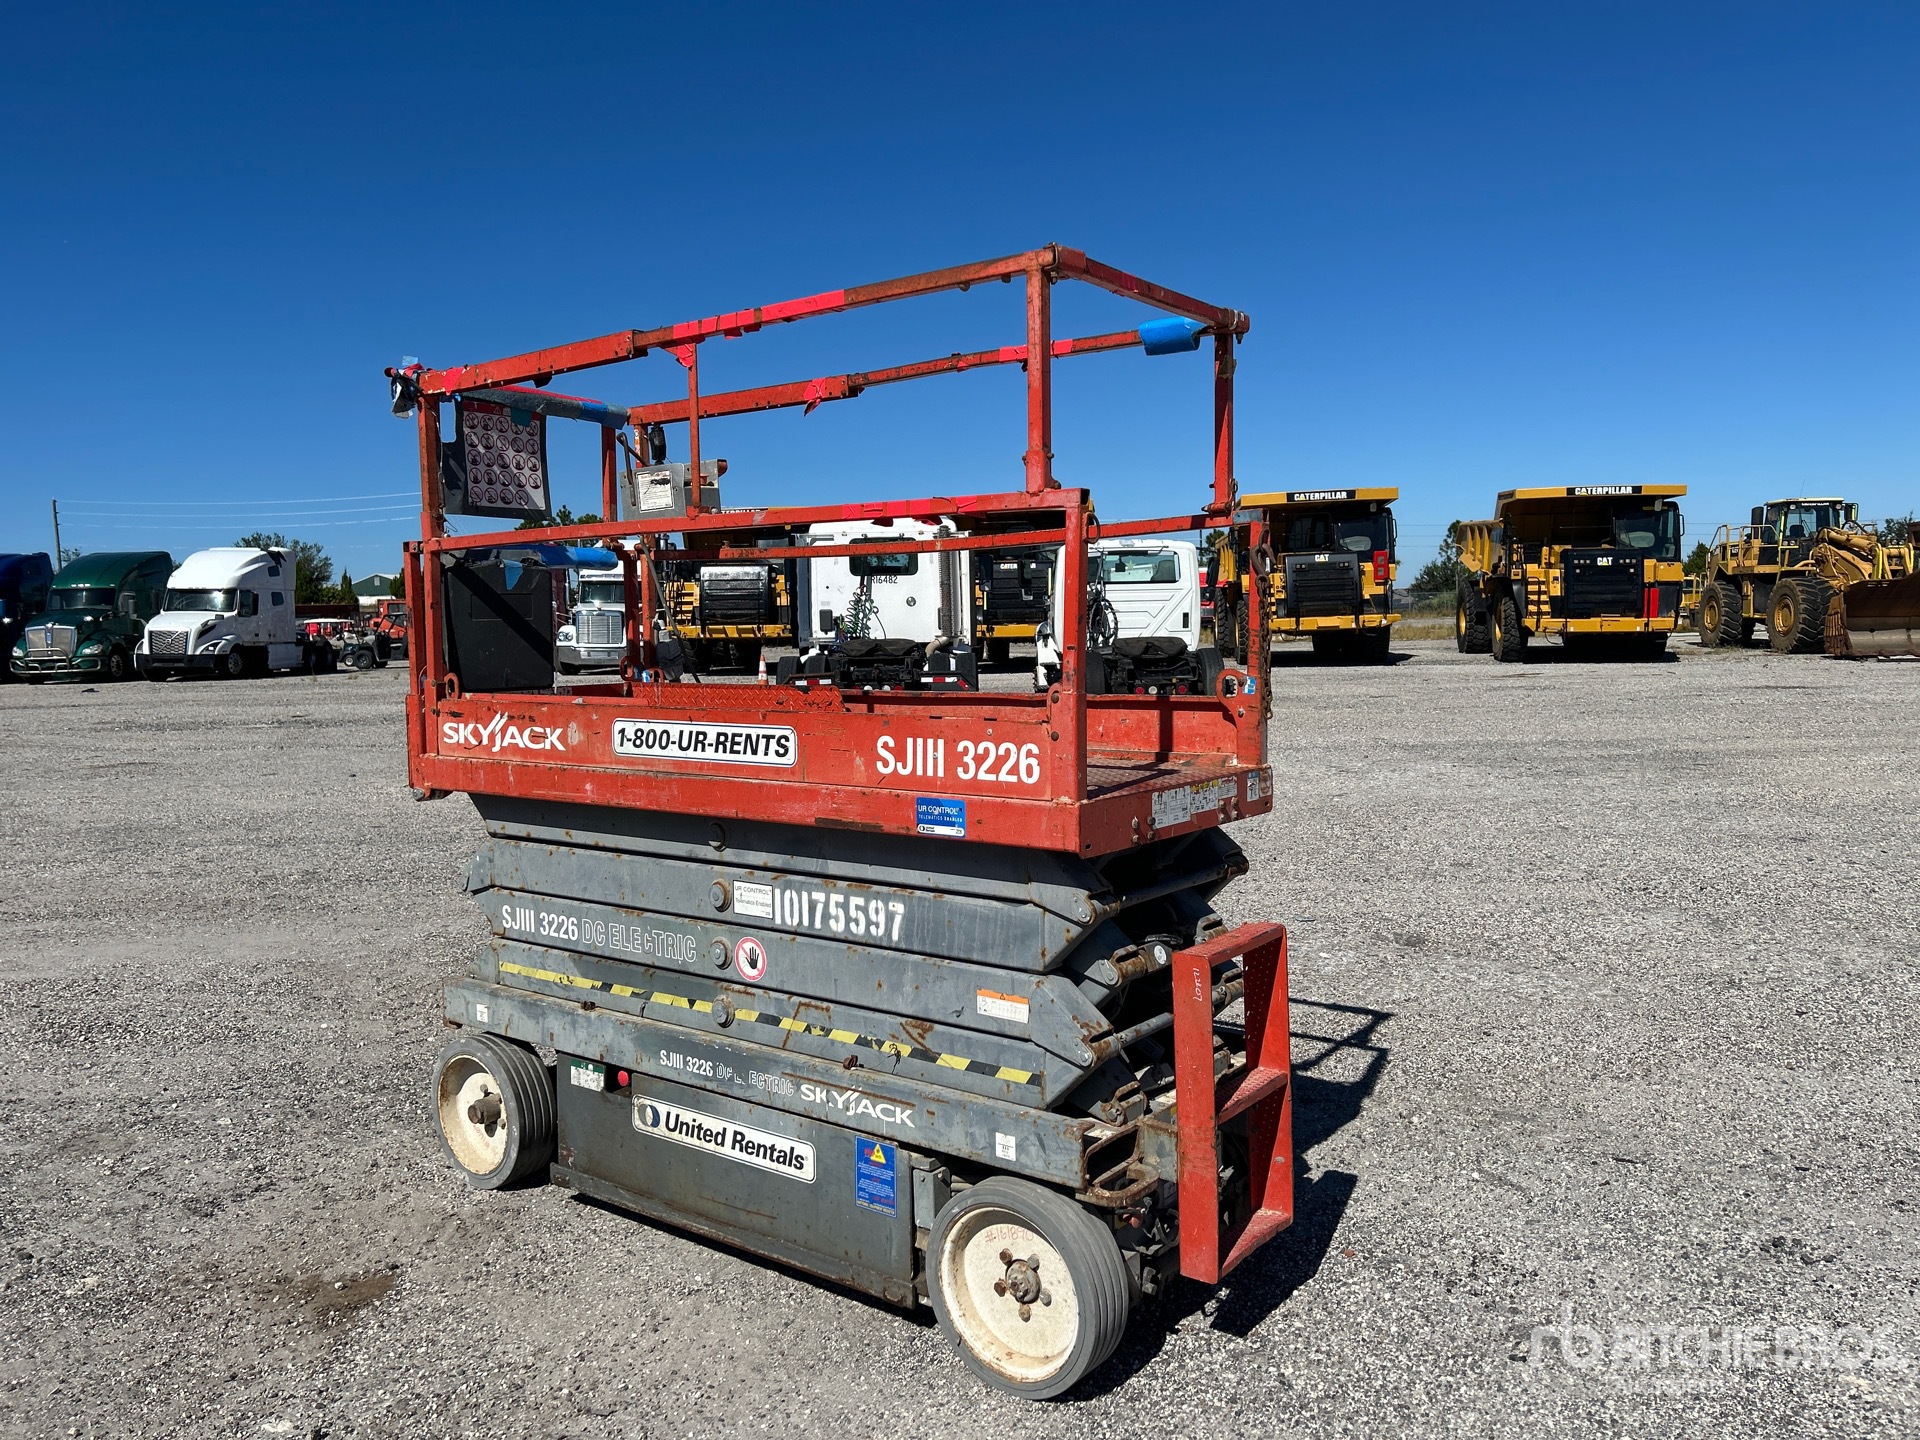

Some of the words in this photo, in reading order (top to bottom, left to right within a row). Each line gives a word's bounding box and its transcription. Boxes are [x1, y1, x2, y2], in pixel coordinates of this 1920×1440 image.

[1294, 491, 1347, 501] CATERPILLAR
[1575, 486, 1632, 496] CATERPILLAR
[1315, 554, 1329, 562] CAT
[1597, 557, 1613, 566] CAT
[443, 710, 566, 752] SKYJACK
[617, 727, 790, 758] 1-800-UR-RENTS
[956, 740, 1041, 784] 3226
[502, 905, 535, 933] SJIII
[539, 912, 578, 941] 3226
[582, 919, 605, 946] DC
[609, 923, 697, 962] ELECTRIC
[774, 888, 905, 941] 10175597
[660, 1049, 683, 1069] SJIII
[686, 1056, 713, 1077] 3226
[716, 1062, 733, 1079] DC
[734, 1070, 794, 1096] ECTRIC
[800, 1084, 916, 1128] SKYJACK
[665, 1111, 727, 1147] United
[731, 1130, 805, 1170] Rentals
